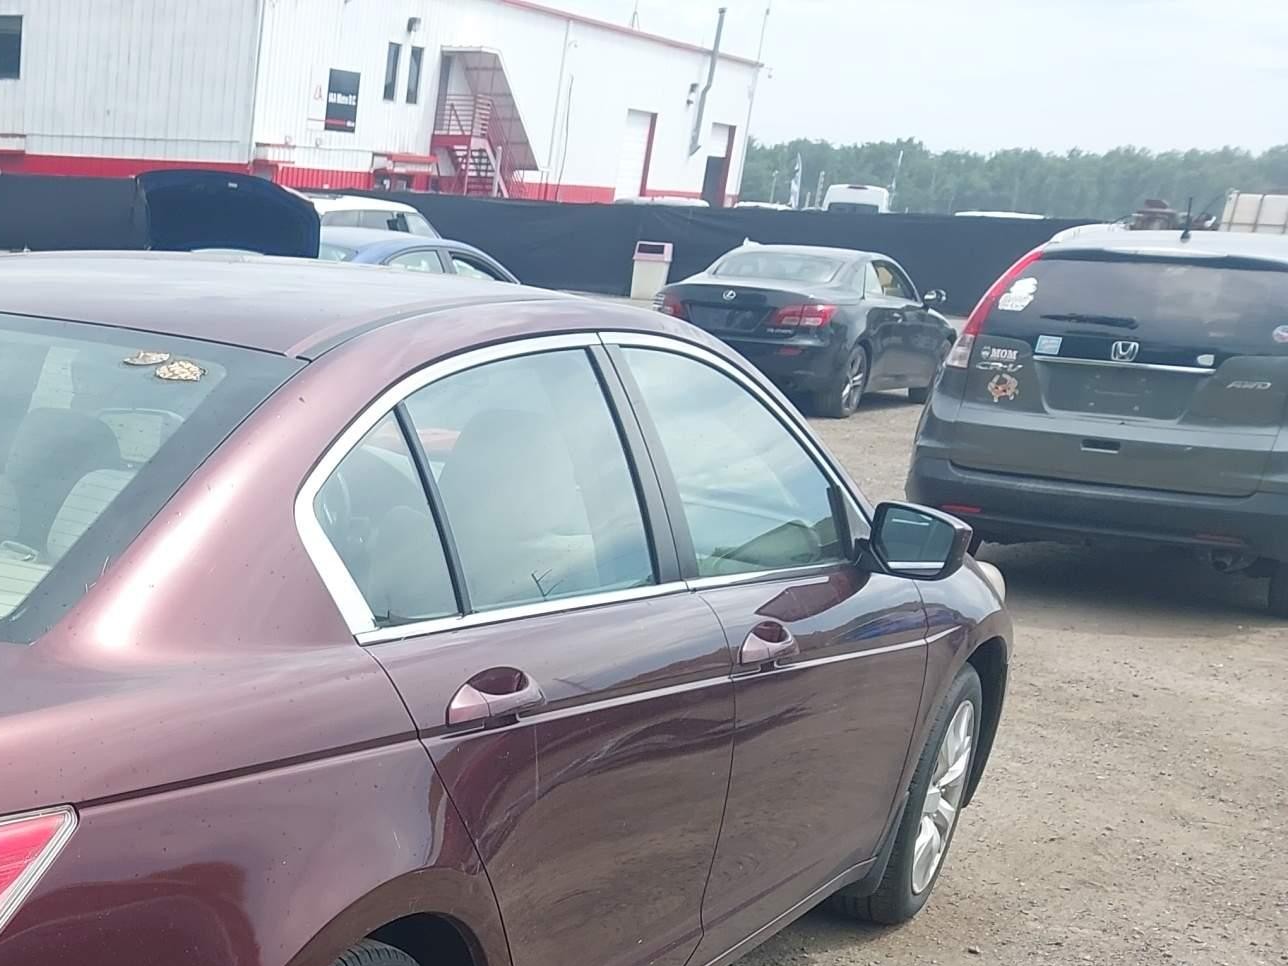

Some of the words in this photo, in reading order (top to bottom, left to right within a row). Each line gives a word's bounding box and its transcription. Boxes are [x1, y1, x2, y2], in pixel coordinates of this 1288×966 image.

[990, 348, 1018, 359] MOM
[976, 362, 1023, 372] CR-V
[1226, 381, 1272, 389] AWD
